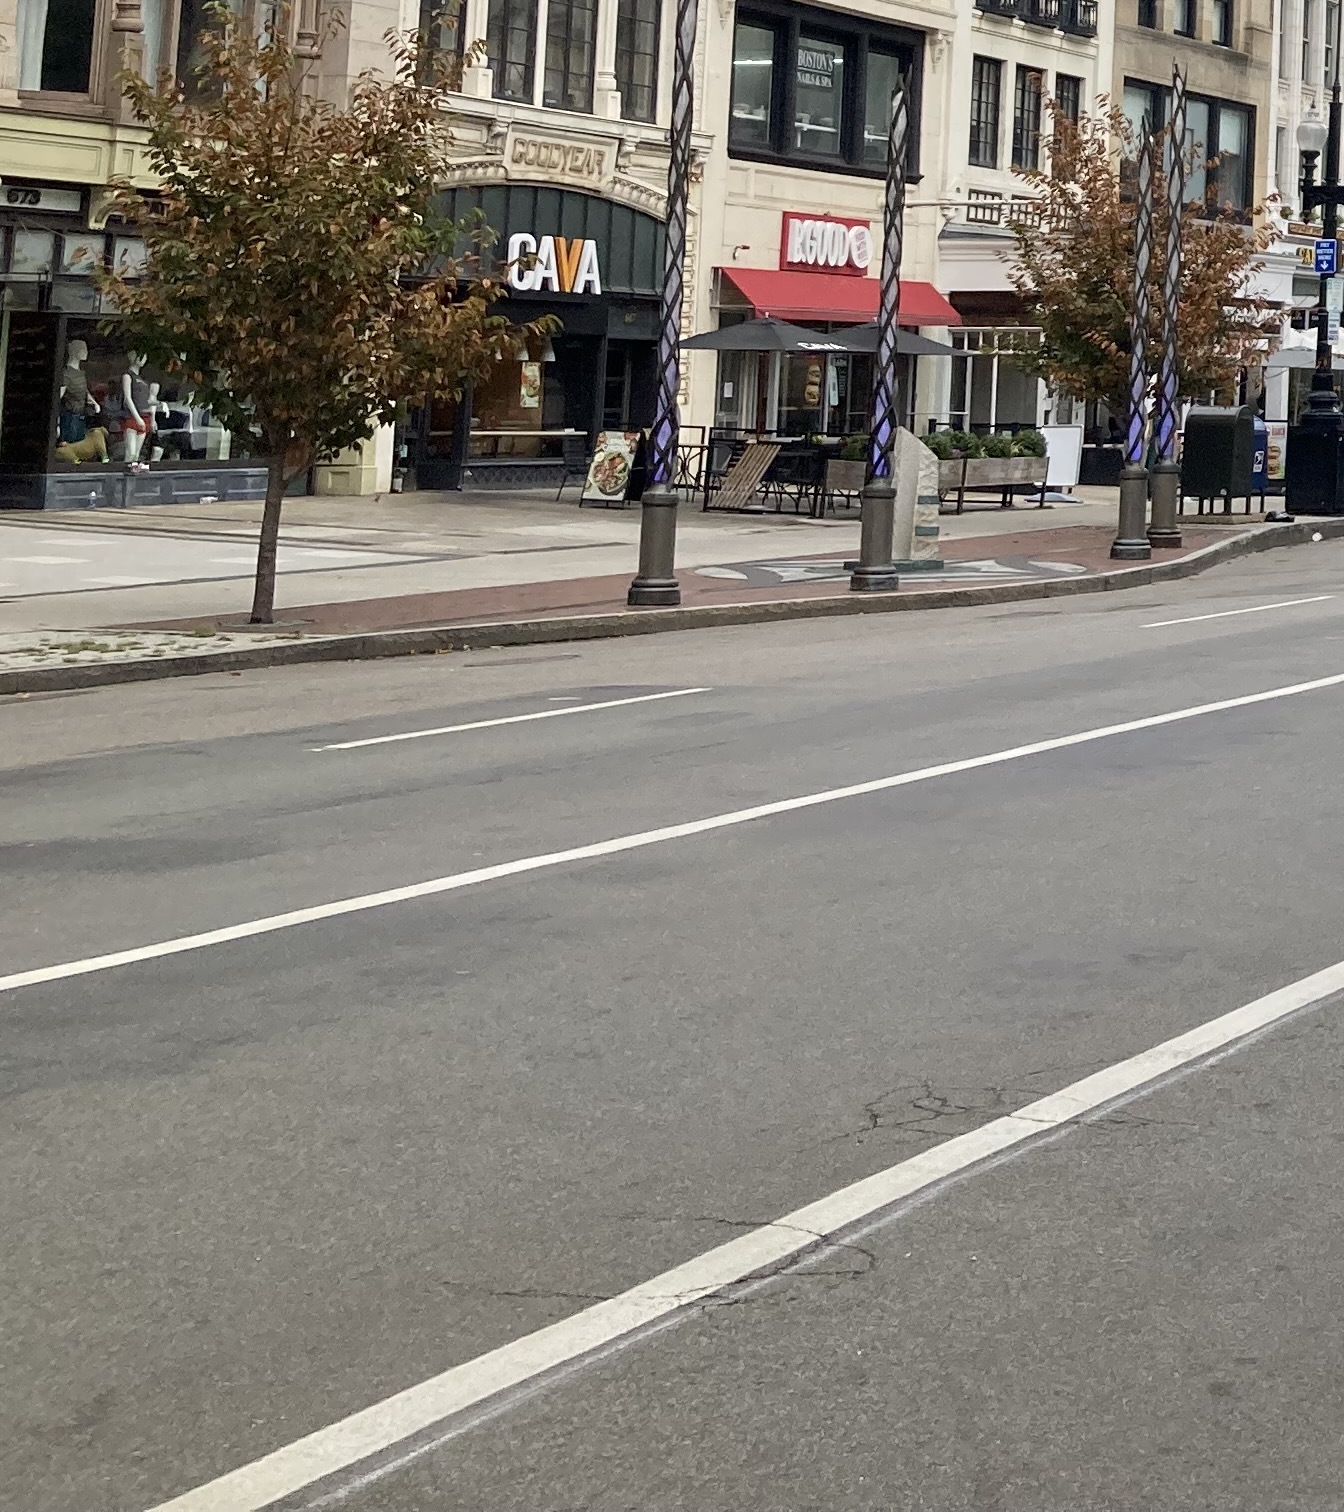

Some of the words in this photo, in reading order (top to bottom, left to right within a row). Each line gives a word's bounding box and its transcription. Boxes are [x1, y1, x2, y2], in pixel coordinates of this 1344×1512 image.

[798, 49, 833, 71] BOSTON'S
[797, 72, 815, 85] NAILS
[821, 77, 832, 87] SPA
[511, 138, 606, 176] GOODYEAR
[508, 233, 601, 295] CAVA
